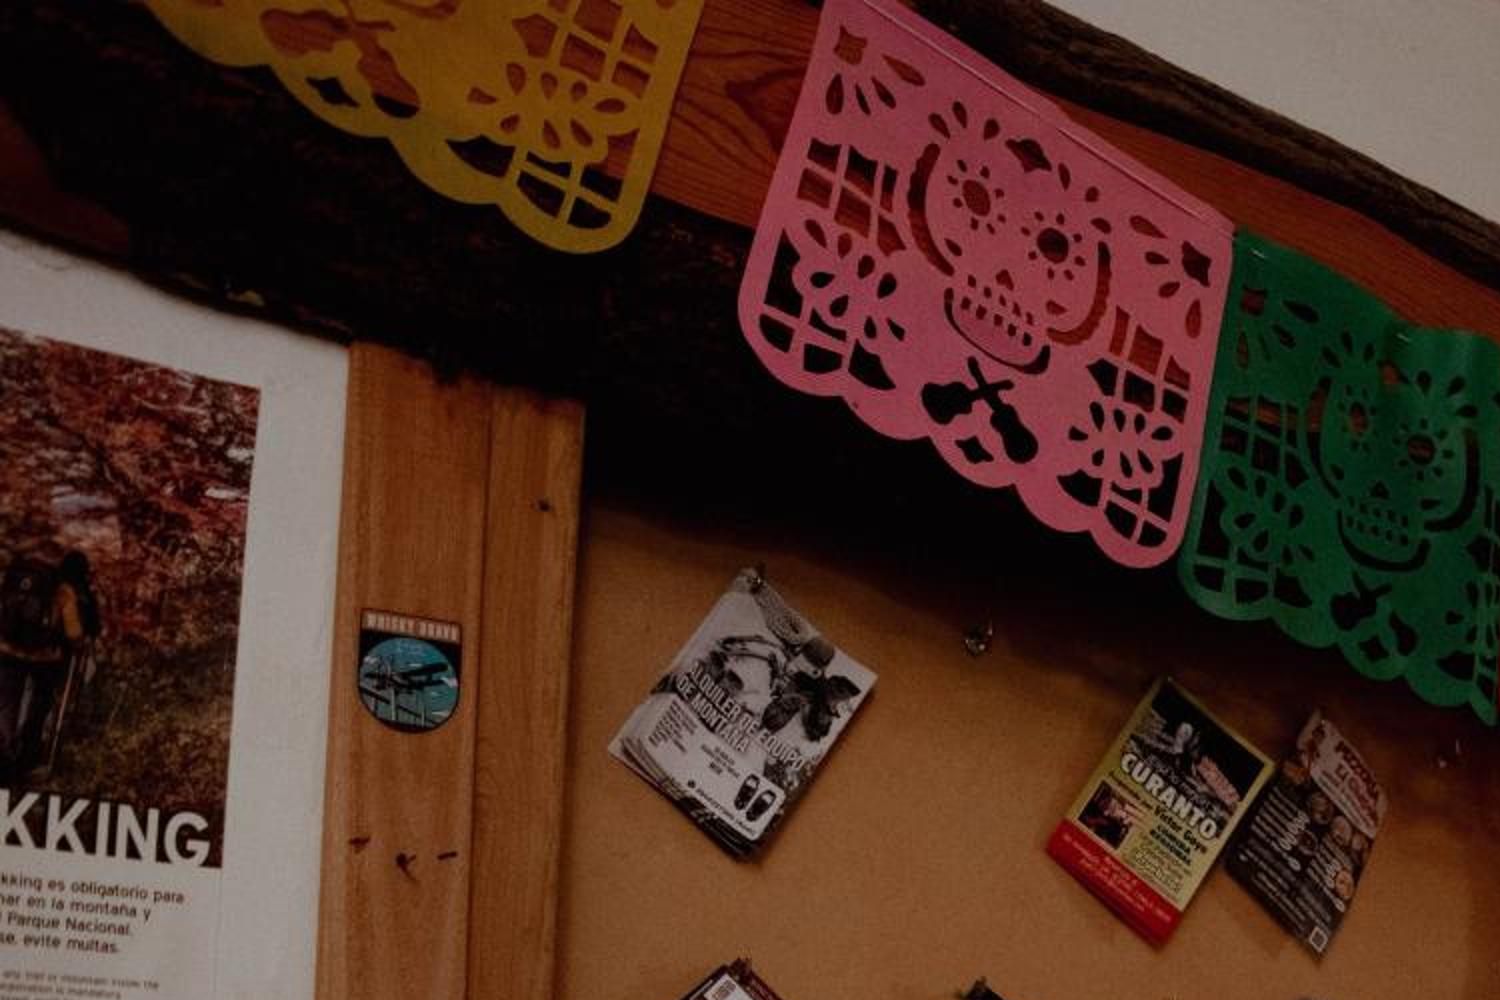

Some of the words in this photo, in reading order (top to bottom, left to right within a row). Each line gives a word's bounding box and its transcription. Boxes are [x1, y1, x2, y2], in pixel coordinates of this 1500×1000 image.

[759, 733, 807, 771] EQUIPO
[1119, 752, 1219, 841] CURANTO
[48, 881, 65, 892] es
[71, 879, 149, 900] obligatorio
[153, 888, 185, 904] para
[27, 896, 46, 908] en
[51, 894, 65, 910] la
[70, 899, 137, 918] montaña
[143, 907, 152, 921] y
[7, 912, 61, 930] Parque
[23, 936, 61, 949] evite
